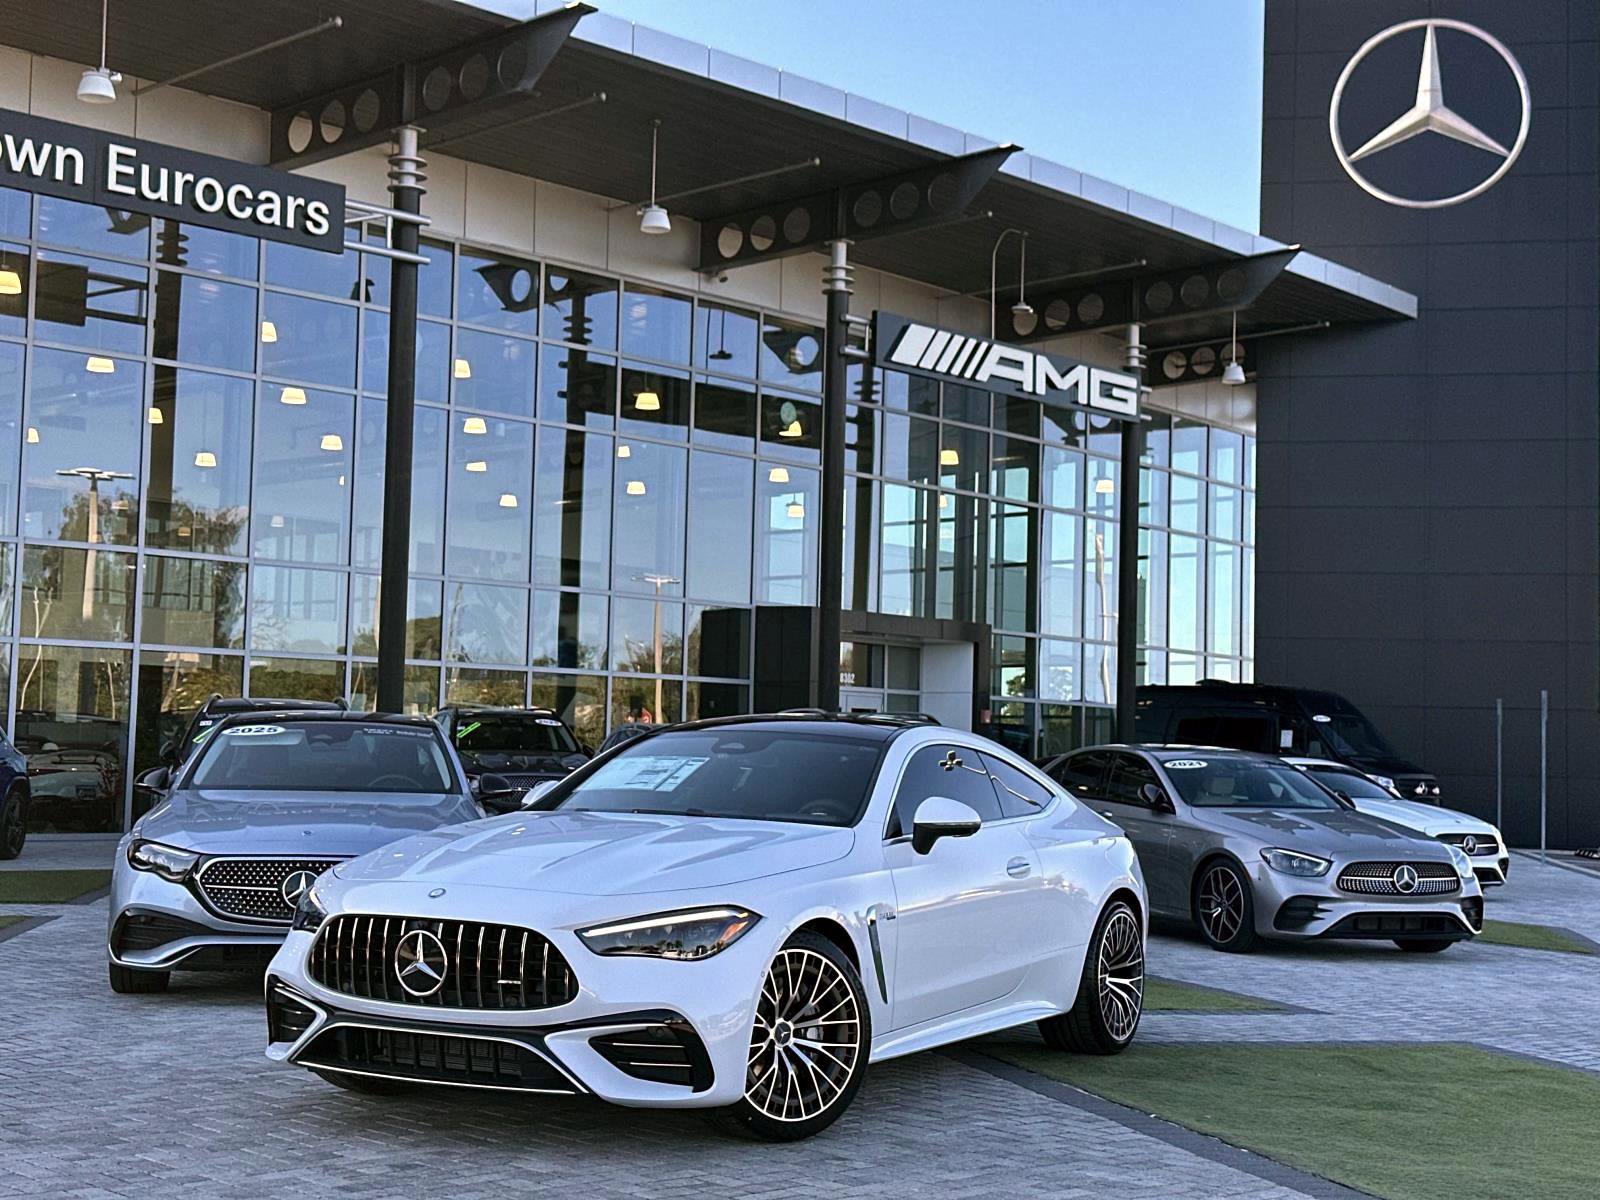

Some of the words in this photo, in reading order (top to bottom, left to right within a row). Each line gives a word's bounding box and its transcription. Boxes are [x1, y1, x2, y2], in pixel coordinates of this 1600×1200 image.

[0, 134, 84, 185] wn
[107, 143, 330, 236] Eurocars
[974, 343, 1138, 416] AMG
[229, 726, 278, 734] 2025
